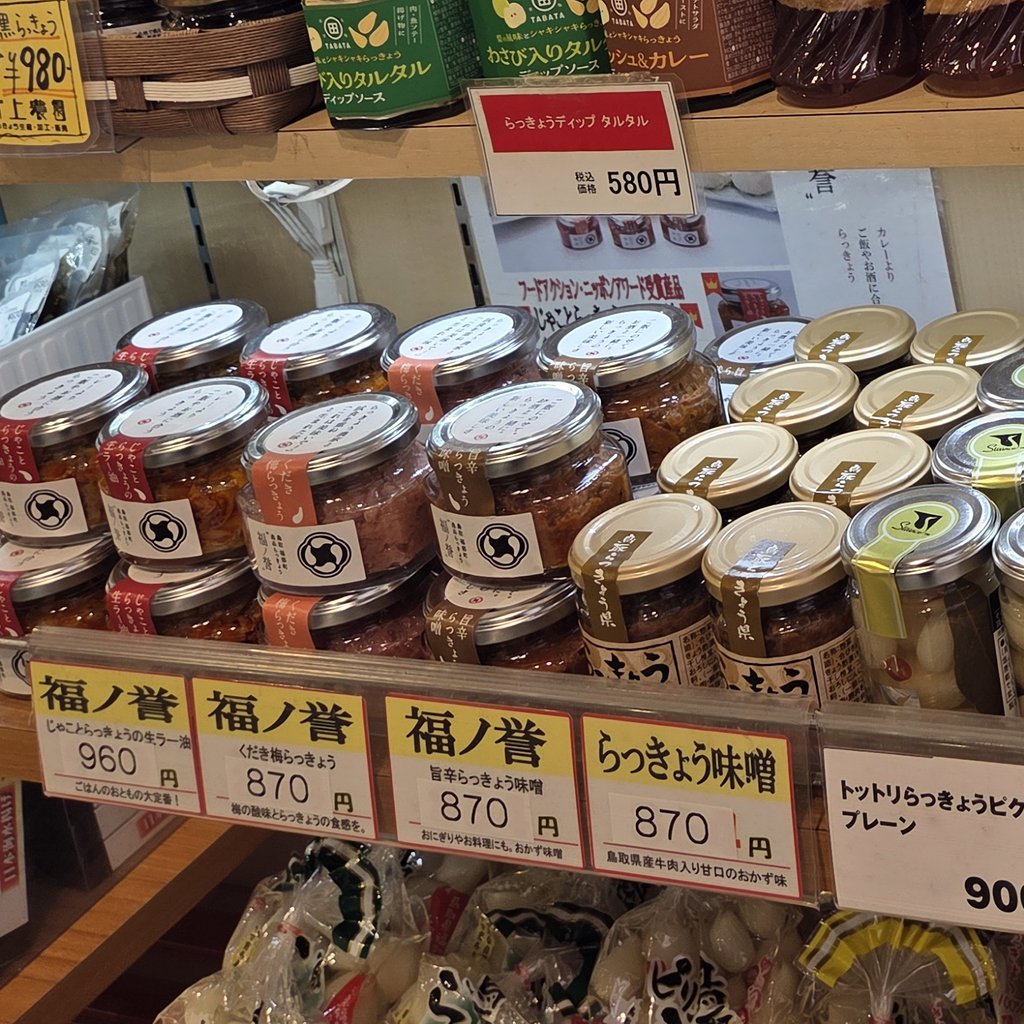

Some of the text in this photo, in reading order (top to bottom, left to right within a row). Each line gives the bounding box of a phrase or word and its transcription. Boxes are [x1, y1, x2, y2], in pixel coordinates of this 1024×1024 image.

[530, 12, 566, 24] TABATA
[504, 113, 650, 131] らっきょうディップ タルタル
[574, 167, 682, 197] 税込 580円
[576, 183, 598, 196] 価格
[836, 228, 856, 284] らっきょう
[876, 227, 895, 284] カレーより
[38, 675, 180, 724] 福ノ誉
[206, 689, 354, 745] 福ノ誉
[46, 718, 192, 751] じゃことらっきょうの生ラー油
[238, 744, 337, 770] くだき梅らっきょう
[404, 705, 548, 768] 福ノ誉
[78, 741, 179, 788] 960 円
[429, 765, 545, 796] 旨辛らっきょう味噌
[598, 729, 777, 795] らっきょう味噌
[246, 767, 354, 813] 870 円
[440, 791, 560, 838] 870 円
[633, 805, 772, 861] 870 円
[841, 810, 917, 836] プレーン
